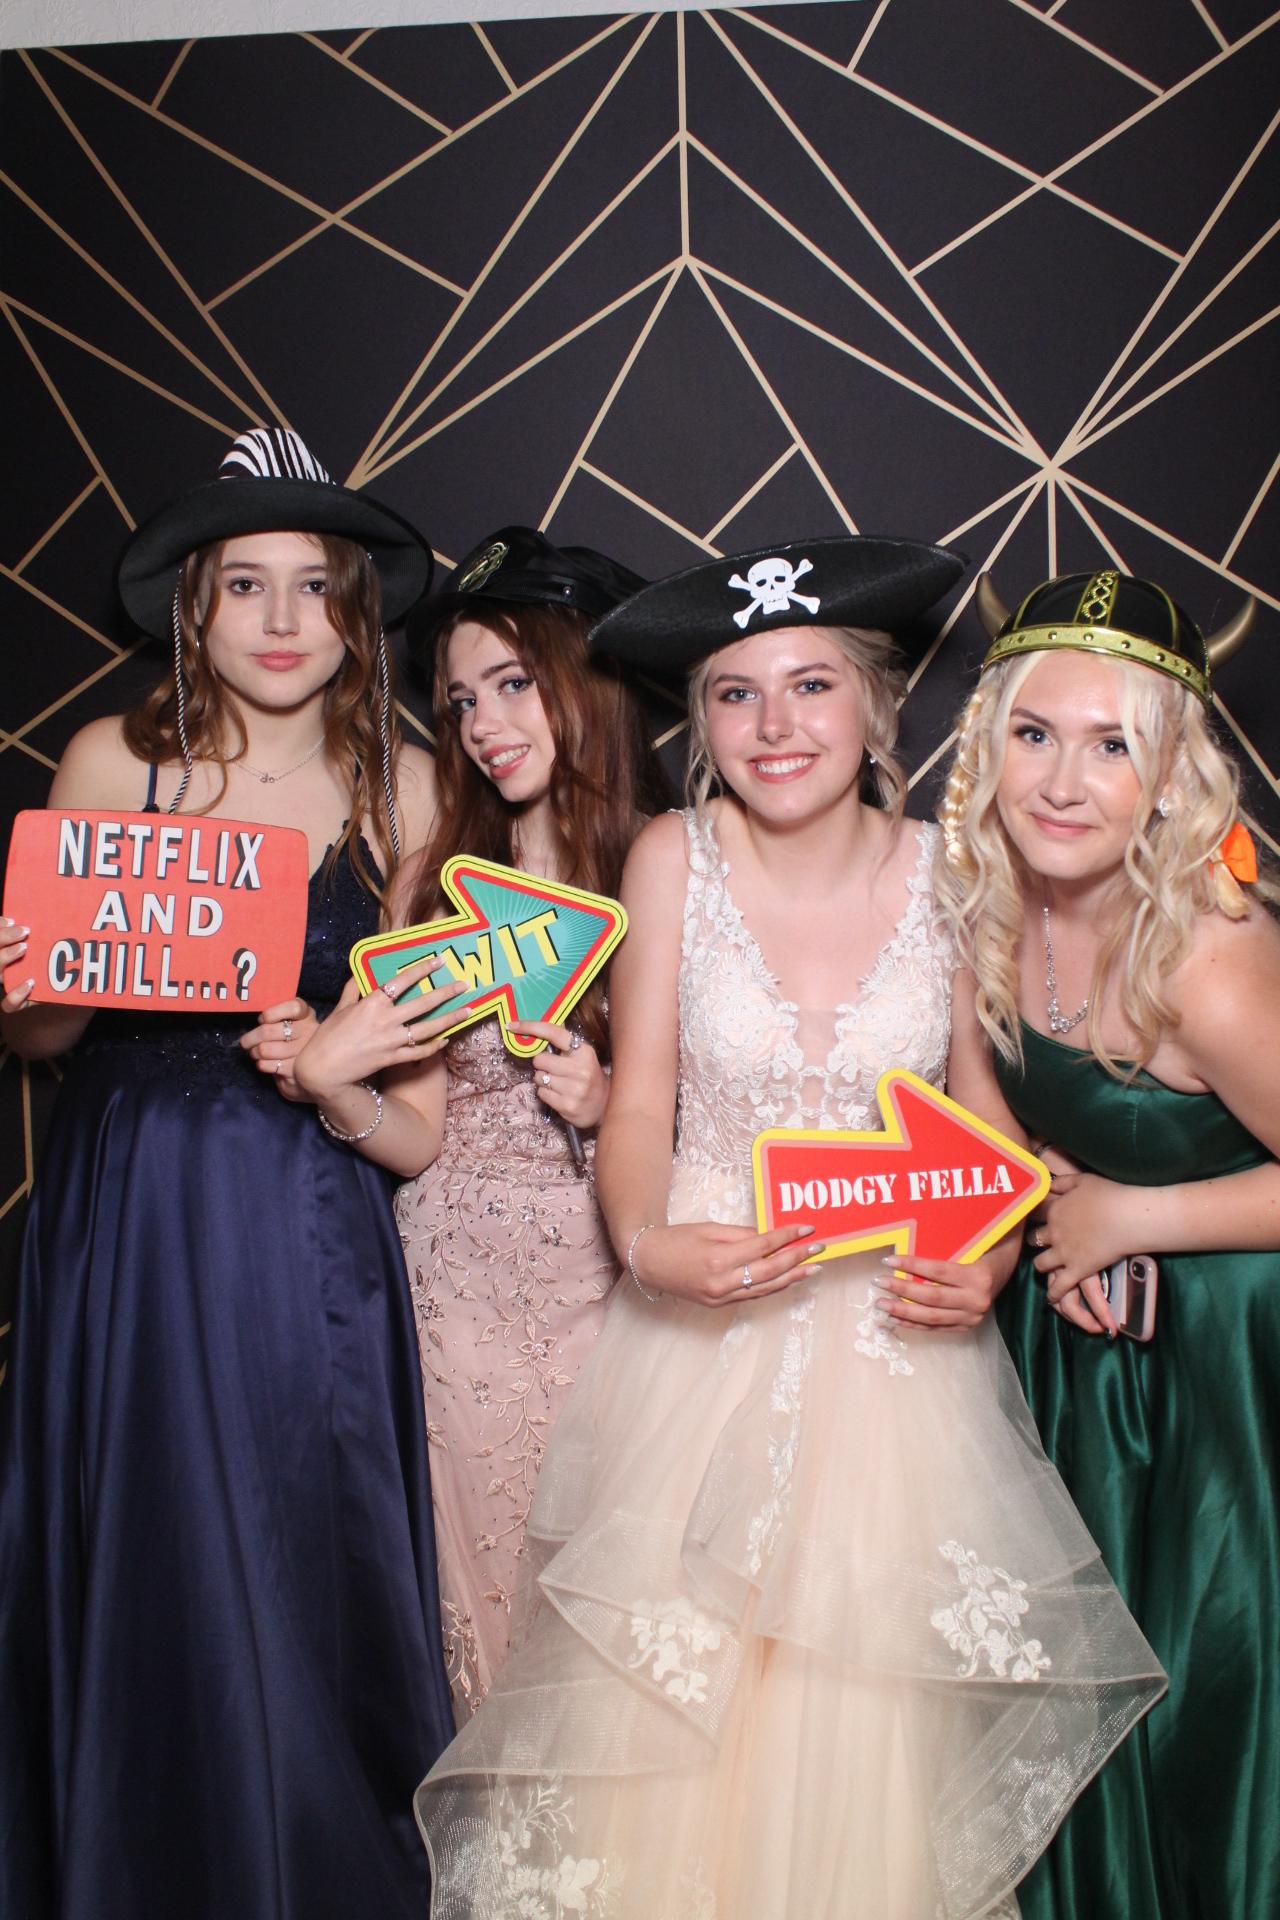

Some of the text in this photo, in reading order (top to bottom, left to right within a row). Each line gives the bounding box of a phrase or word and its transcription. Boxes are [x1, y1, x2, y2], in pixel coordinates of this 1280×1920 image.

[57, 818, 264, 890] NETFLIX
[91, 890, 223, 937] AND
[48, 938, 257, 1001] CHILL...?
[778, 1164, 1014, 1212] DODGY FELLA
